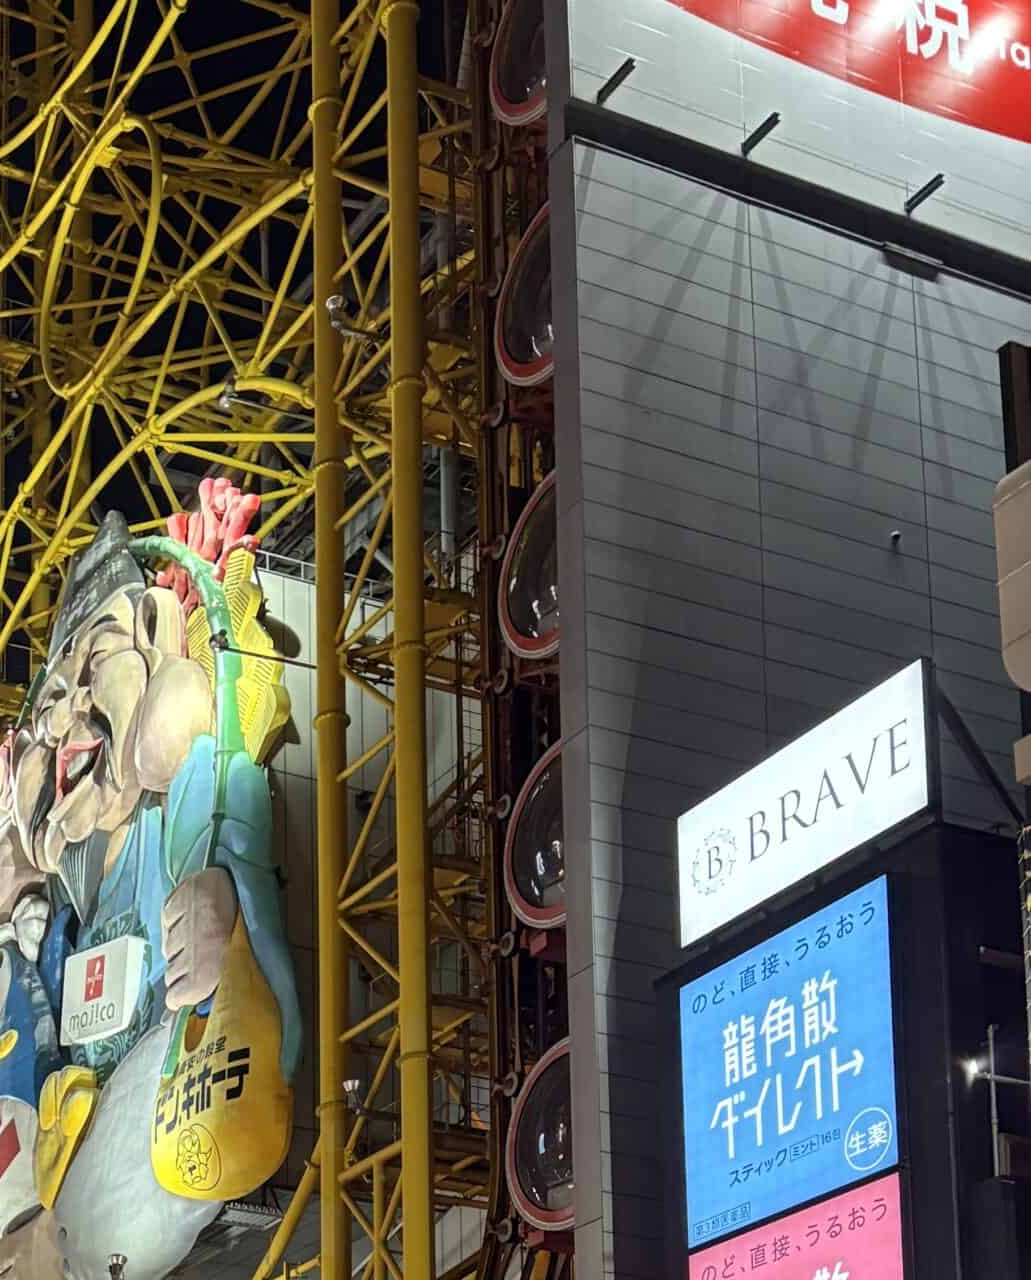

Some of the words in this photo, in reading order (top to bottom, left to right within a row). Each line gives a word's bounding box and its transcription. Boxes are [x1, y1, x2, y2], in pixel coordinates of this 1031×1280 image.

[745, 716, 913, 865] BRAVE
[691, 900, 877, 1015] のど、直接、うるおう
[721, 968, 839, 1088] 龍角散
[709, 1048, 865, 1160] ダイレクト
[846, 1121, 890, 1159] 生薬
